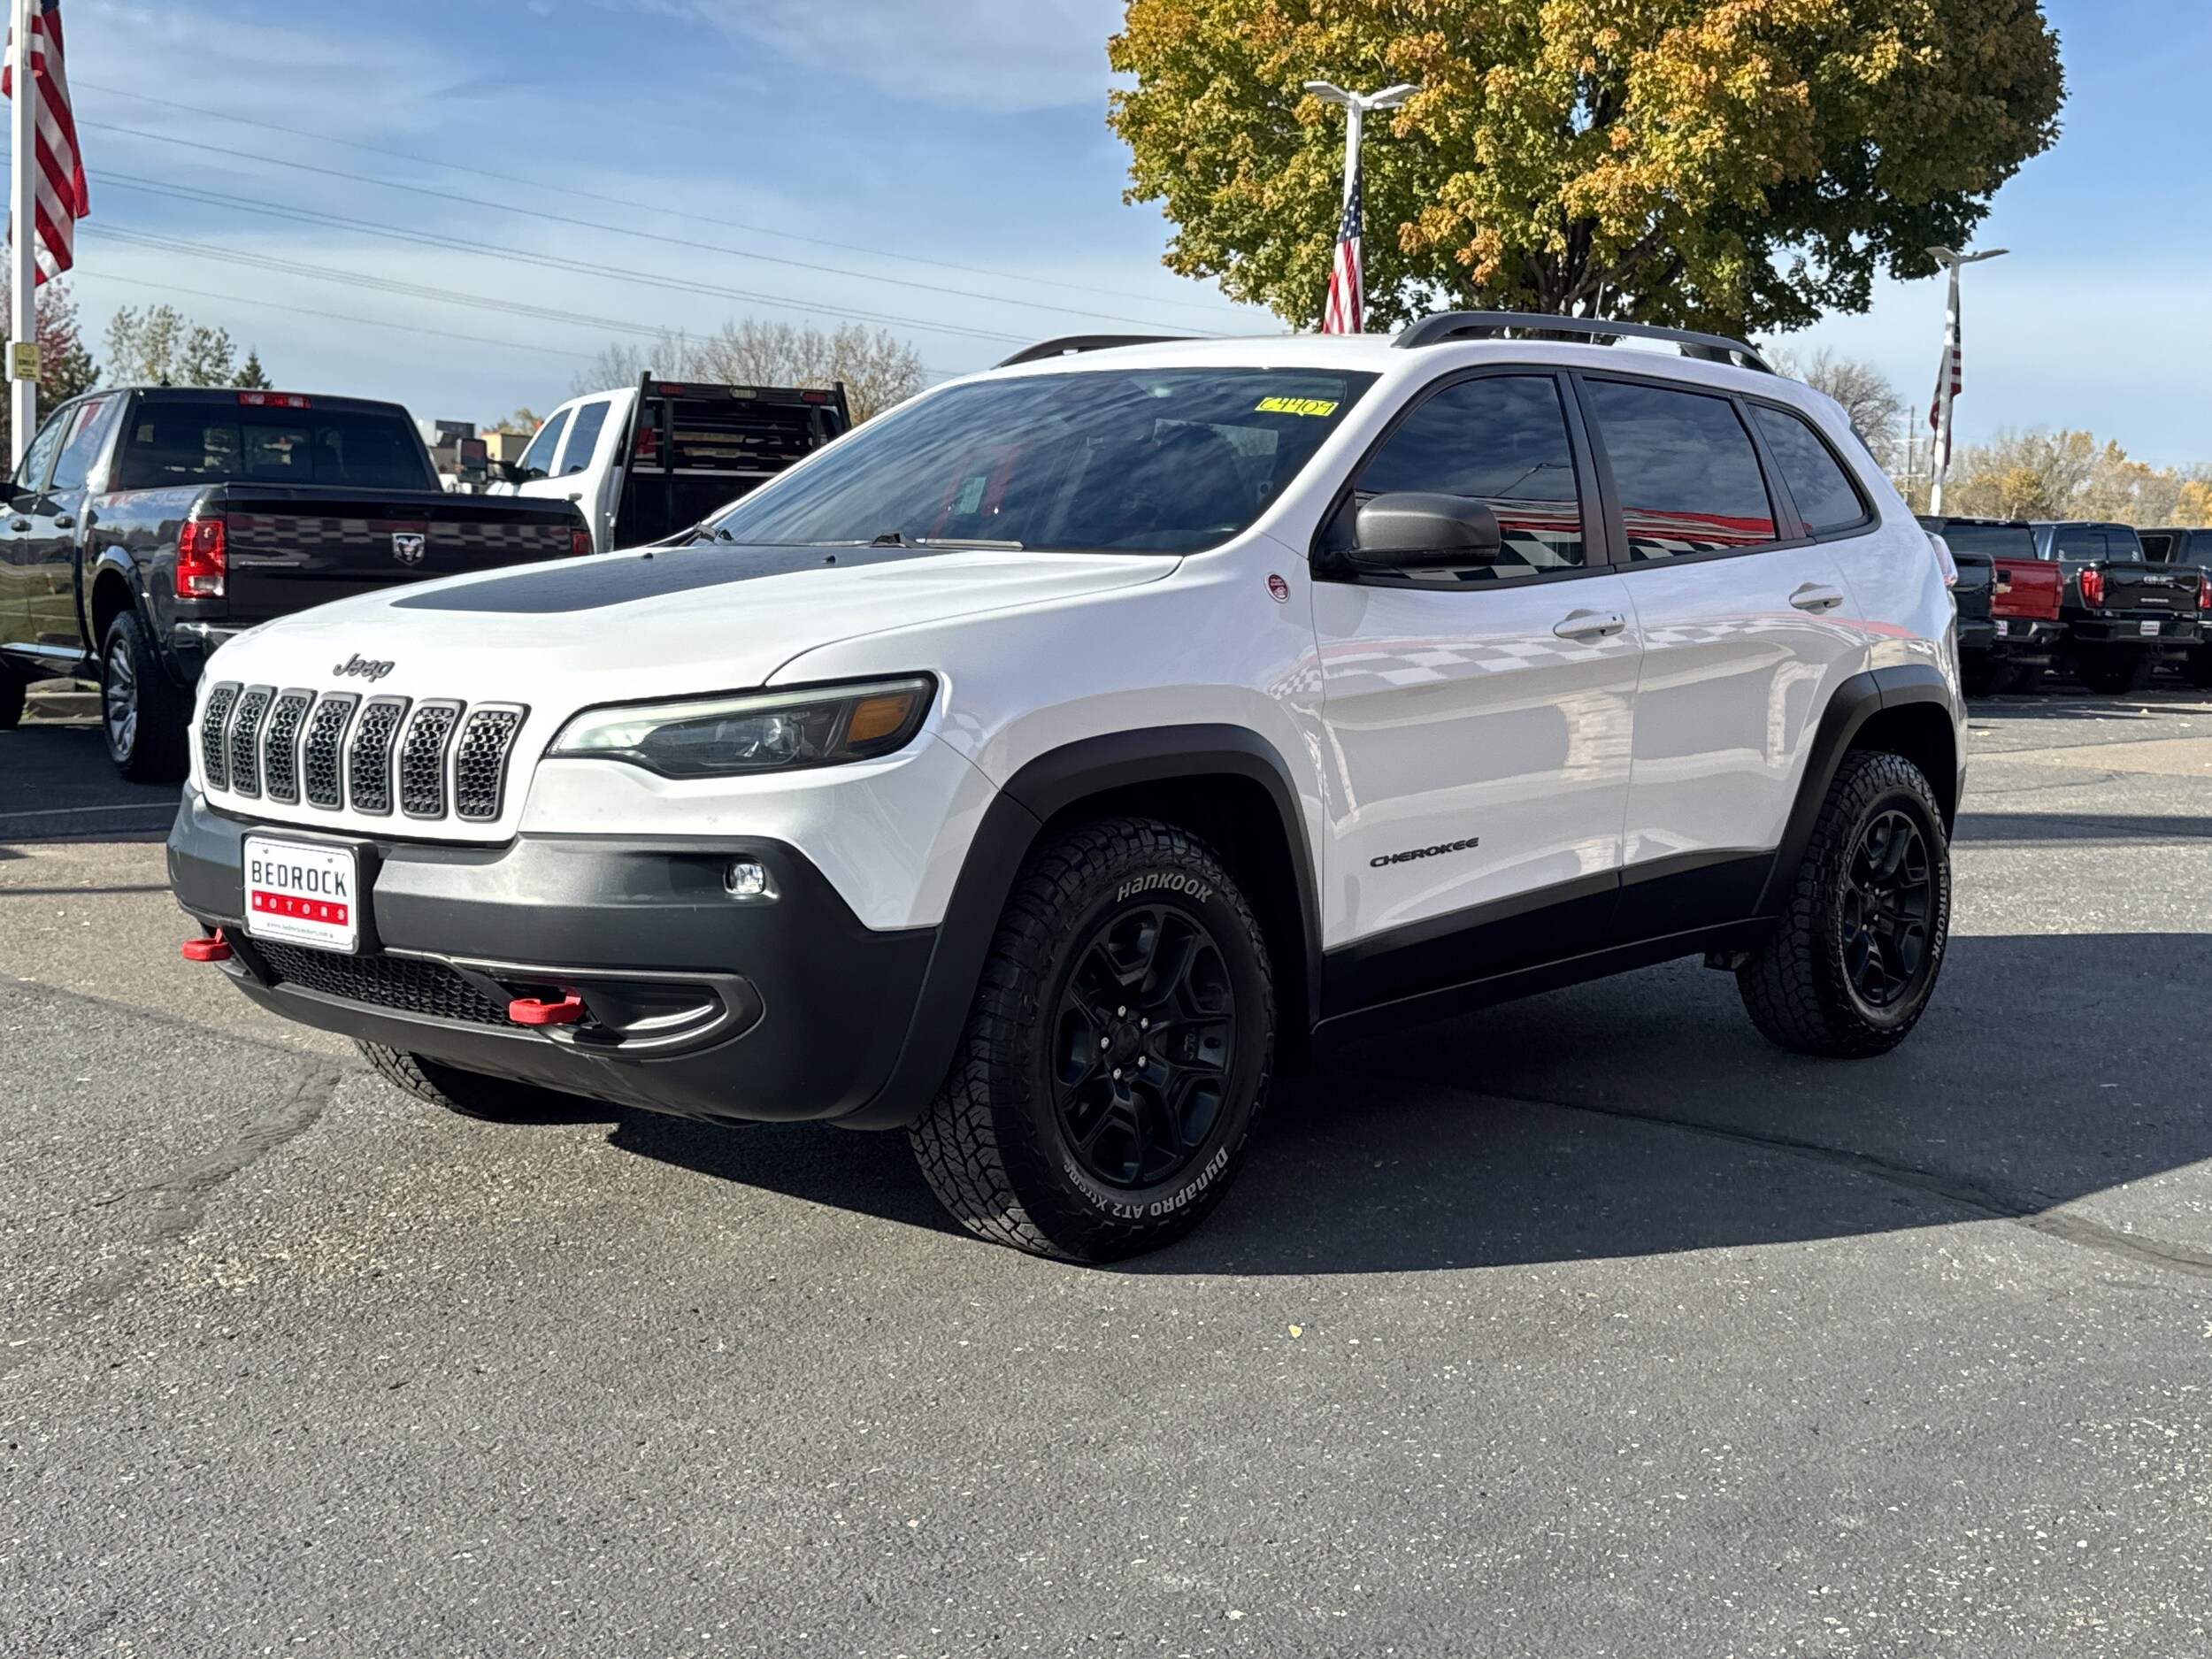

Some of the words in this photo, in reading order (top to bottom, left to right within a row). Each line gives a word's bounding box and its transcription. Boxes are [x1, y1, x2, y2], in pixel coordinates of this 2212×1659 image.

[333, 653, 396, 683] Jeep
[1370, 837, 1479, 867] CHEROKEE
[251, 859, 348, 898] BEDROCK
[254, 895, 345, 920] MOTORS
[1063, 1161, 1108, 1211] Xtreme
[1111, 1202, 1144, 1219] AT2
